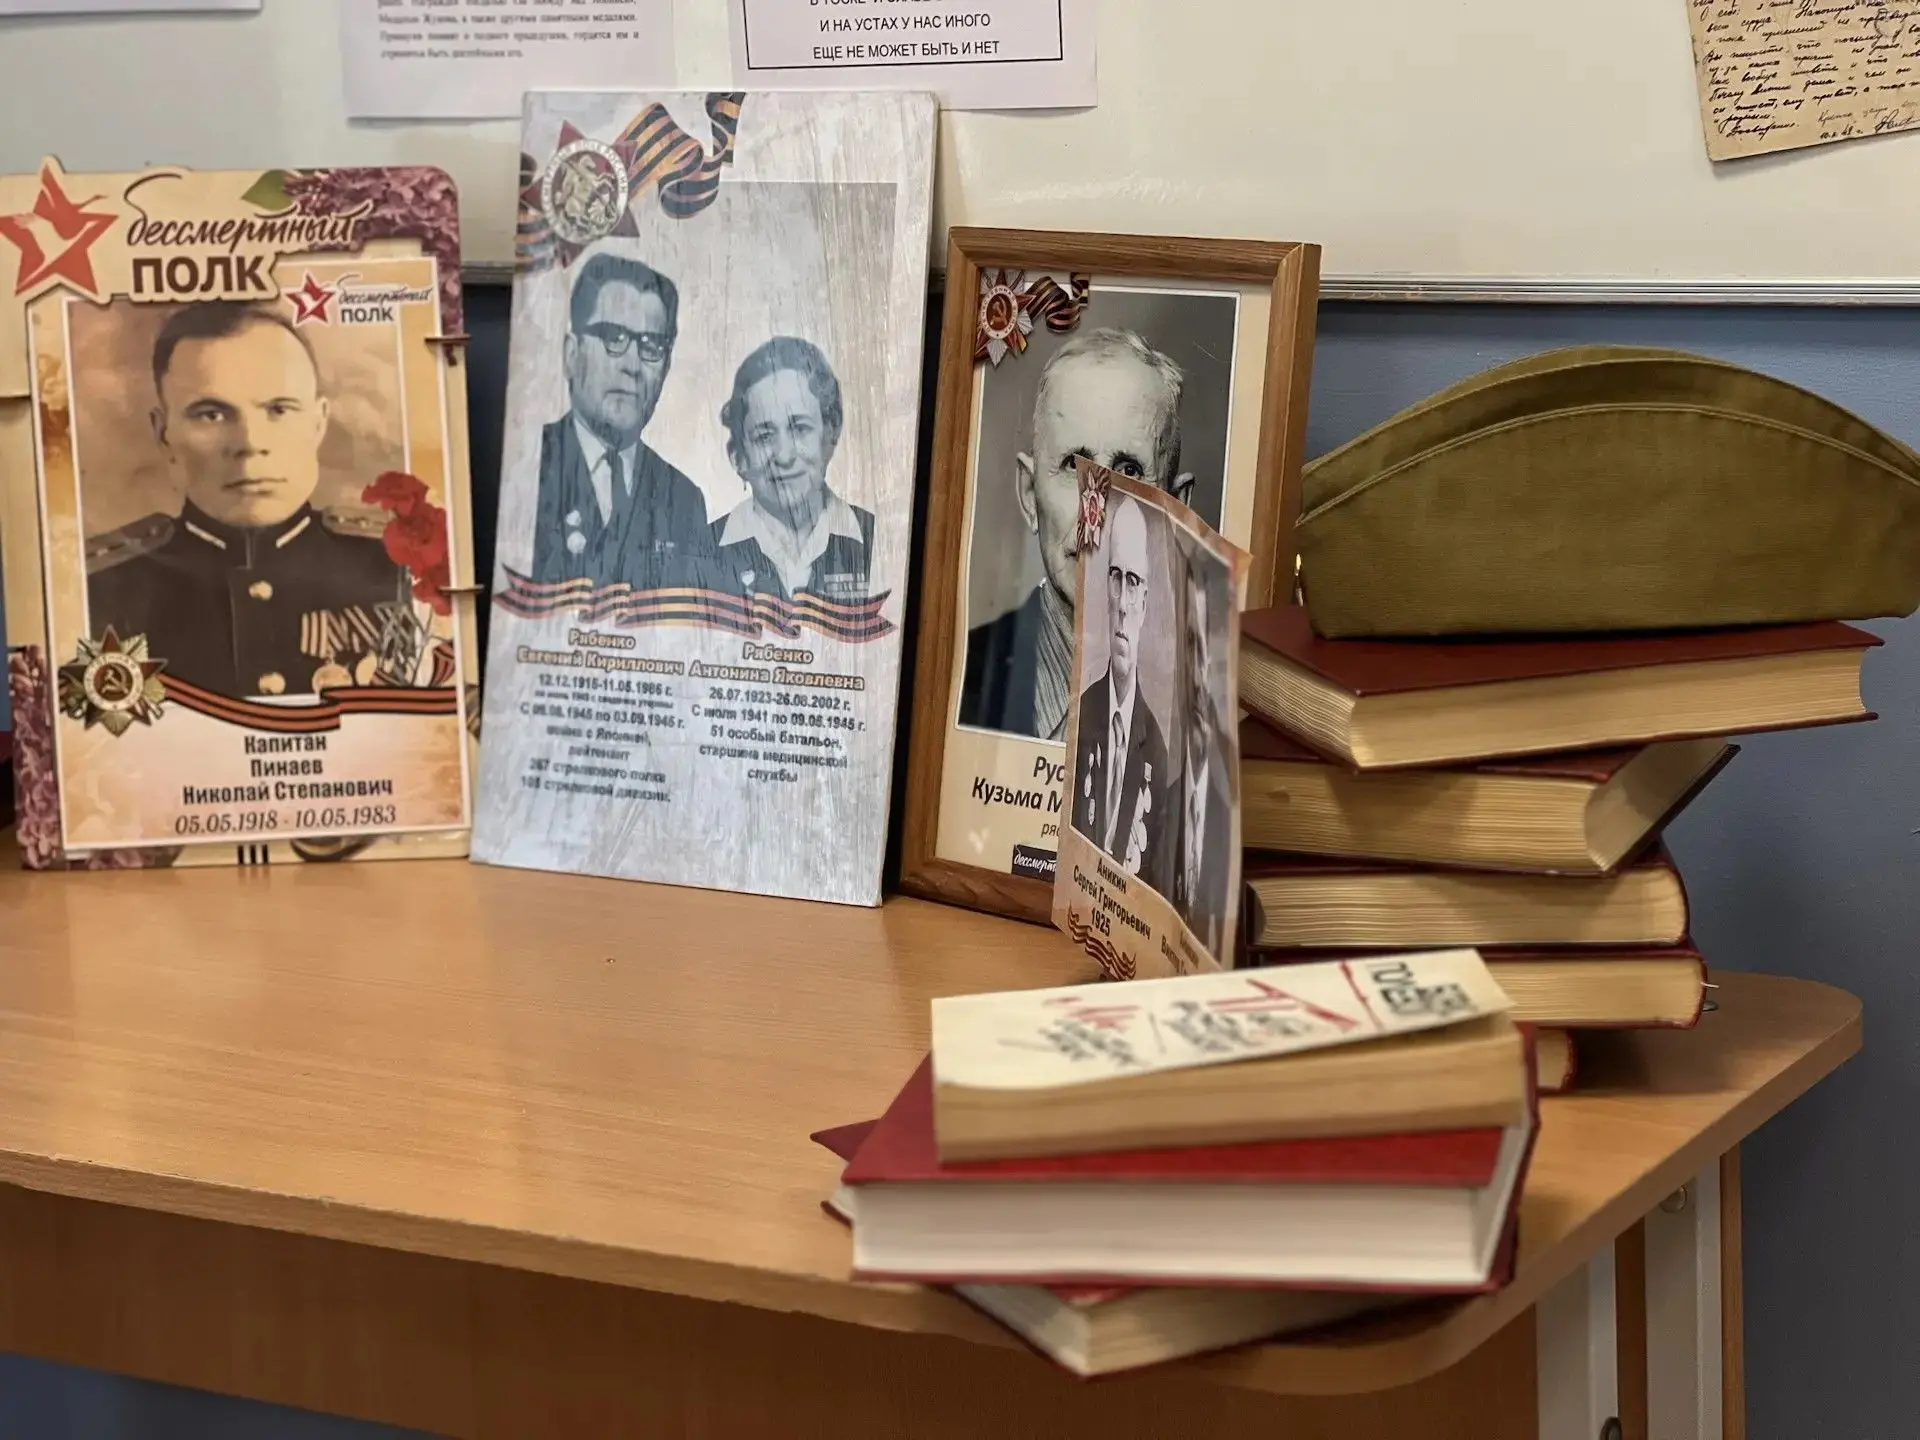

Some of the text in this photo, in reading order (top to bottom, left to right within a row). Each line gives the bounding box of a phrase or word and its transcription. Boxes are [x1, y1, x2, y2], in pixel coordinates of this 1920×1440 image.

[820, 13, 990, 32] И НА УСТАХ У НАС ИНОГО
[813, 41, 1000, 60] ЕЩЕ НЕ МОЖЕТ БЫТЬ И НЕТ
[124, 172, 374, 254] бессмертный
[132, 256, 268, 295] ПОЛК
[337, 273, 433, 306] бессмертный
[341, 306, 394, 323] ПОЛК
[568, 628, 637, 649] Рябенко
[517, 645, 685, 676] Евгений Кириллович
[743, 642, 814, 665] Рябенко
[689, 660, 866, 691] Антонина Яковлевна
[520, 701, 530, 716] С
[691, 704, 701, 717] С
[741, 707, 768, 723] 1941
[771, 712, 788, 725] по
[857, 719, 867, 732] г.
[842, 700, 852, 712] г.
[244, 735, 327, 754] Капитан
[726, 726, 776, 743] особый
[250, 759, 324, 778] Пинаев
[699, 744, 848, 769] старшина медицинской
[747, 768, 799, 784] службы
[183, 778, 393, 805] Николай Степанович
[972, 776, 1044, 810] Кузьма
[175, 808, 279, 835] 05.05.1918
[295, 804, 397, 829] 10.05.1983
[1097, 857, 1127, 895] Аникин
[1073, 864, 1151, 941] Сергей Григорьевич
[1091, 907, 1111, 938] 1925
